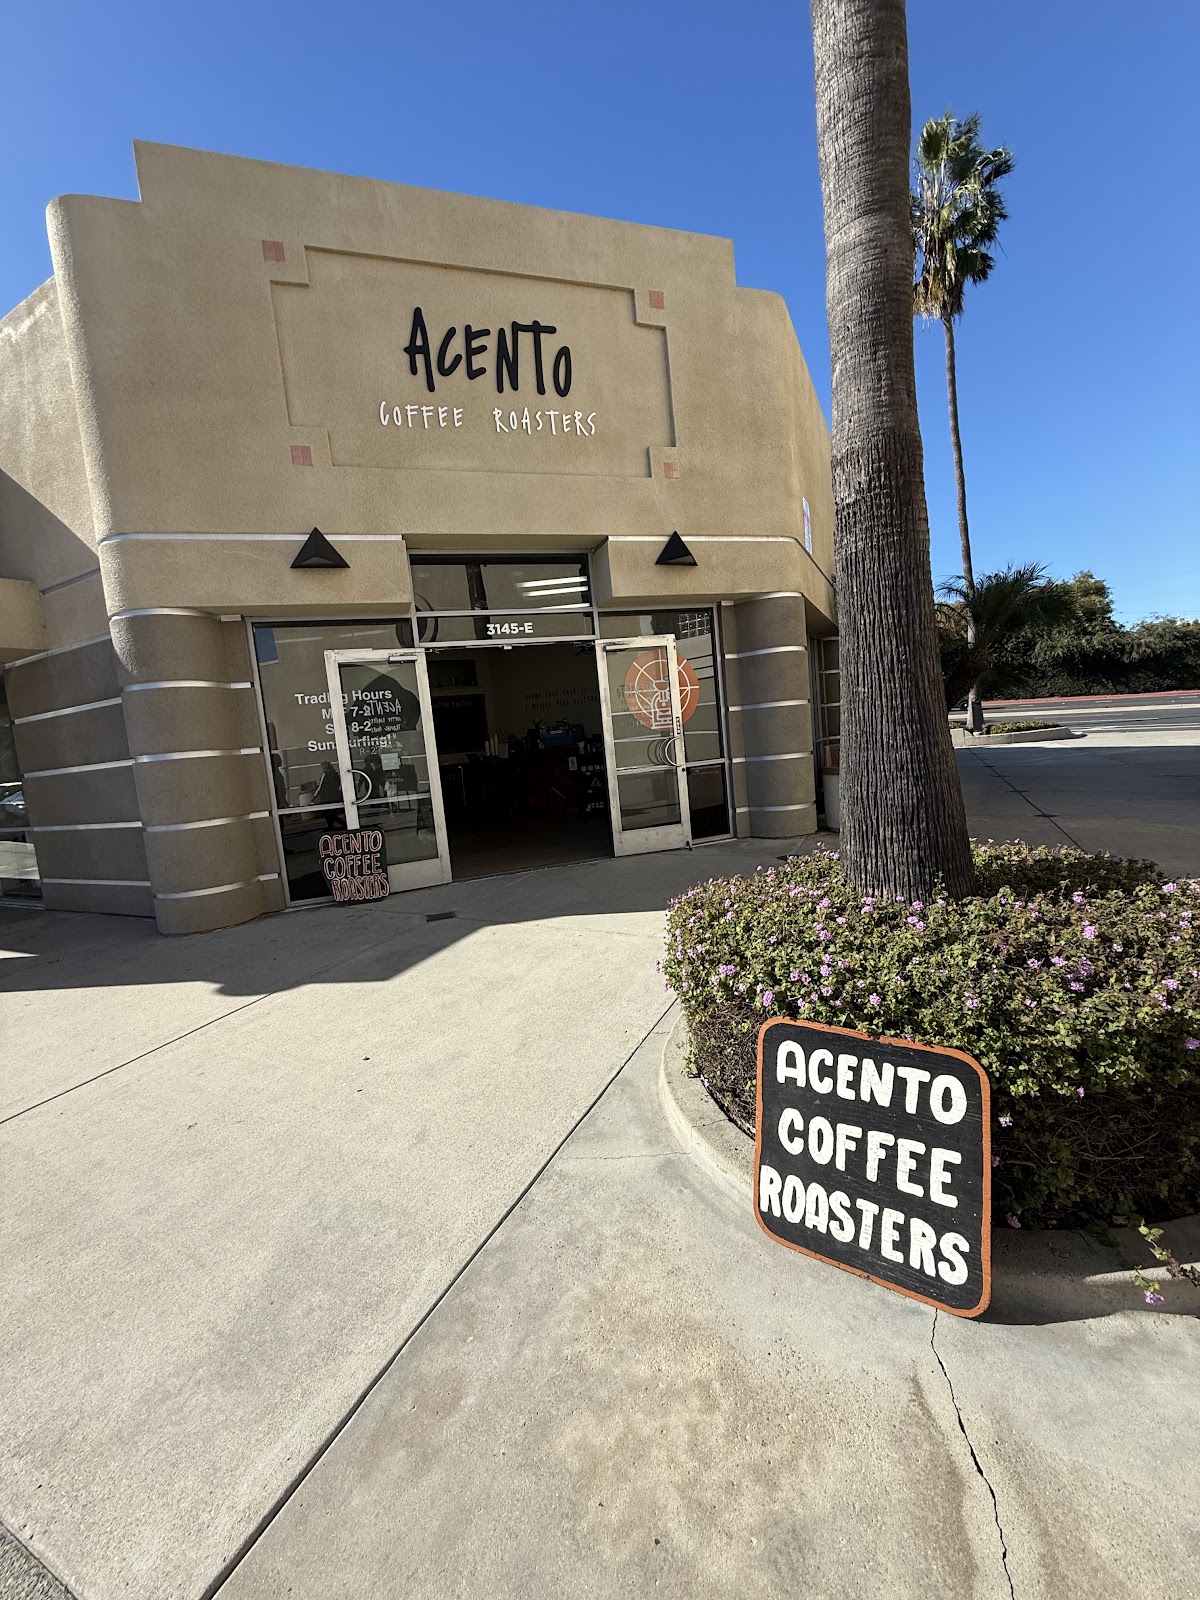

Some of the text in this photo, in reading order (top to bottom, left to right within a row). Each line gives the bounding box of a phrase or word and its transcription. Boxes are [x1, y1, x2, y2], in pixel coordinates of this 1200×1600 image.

[403, 306, 572, 397] ACENTO
[379, 400, 597, 436] COFFEE ROASTERS
[486, 622, 534, 636] 3145-E
[294, 690, 392, 704] Tradig Hours
[349, 733, 392, 748] urfing!
[351, 720, 372, 733] 8-2
[319, 831, 382, 857] ACENTO
[323, 853, 382, 880] COFFEE
[331, 873, 390, 902] ROASTERS
[776, 1039, 967, 1125] ACENTO
[777, 1107, 962, 1208] COFFEE
[759, 1165, 970, 1285] ROASTERS
